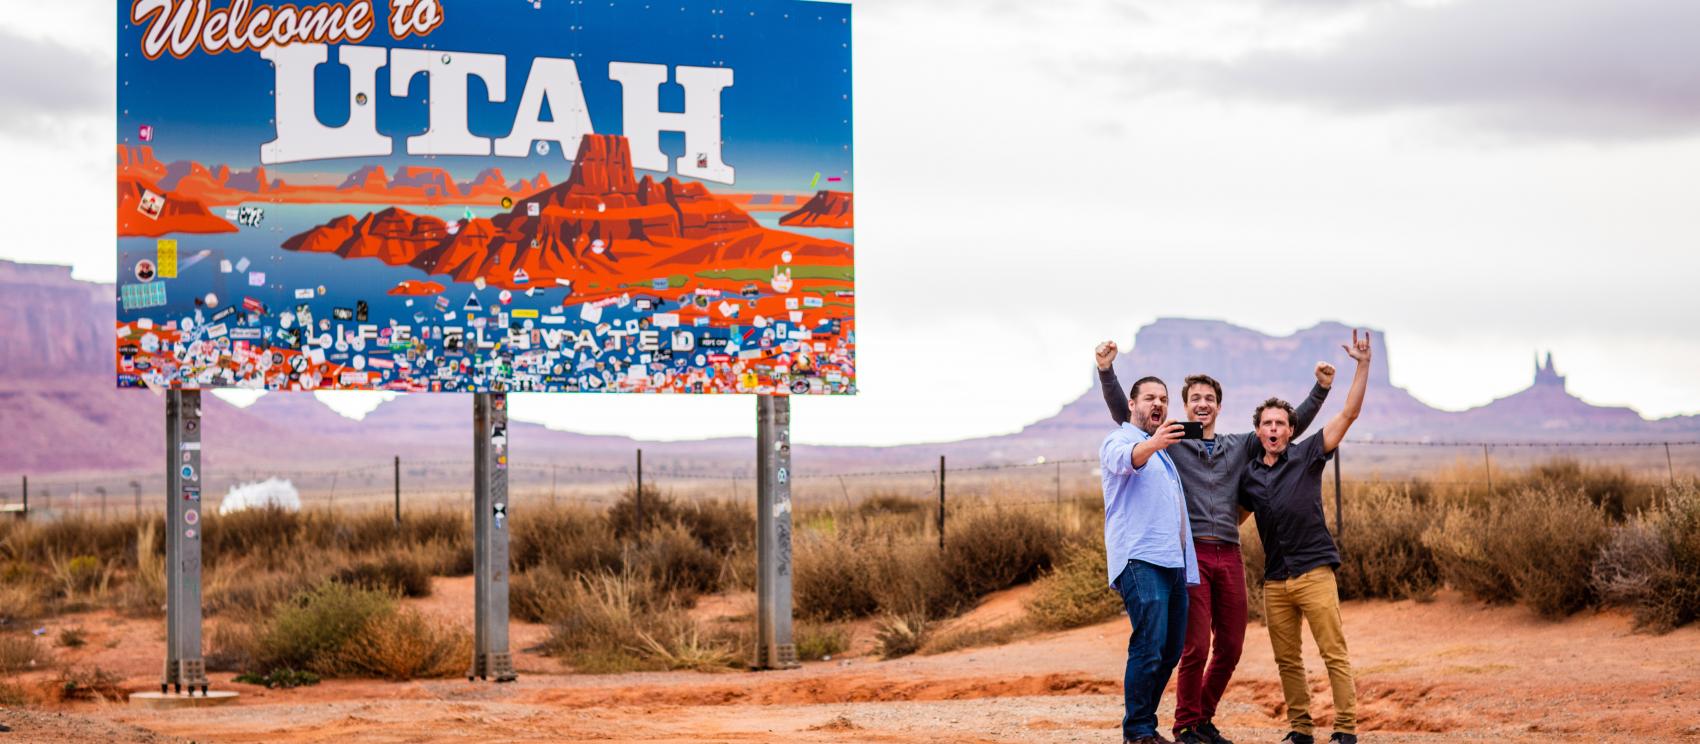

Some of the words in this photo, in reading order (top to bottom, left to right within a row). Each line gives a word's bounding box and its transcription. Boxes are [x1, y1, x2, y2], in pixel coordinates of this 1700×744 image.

[132, 0, 375, 59] Welcome
[388, 0, 444, 40] to
[259, 42, 735, 185] UTAH
[306, 323, 412, 346] LIFE
